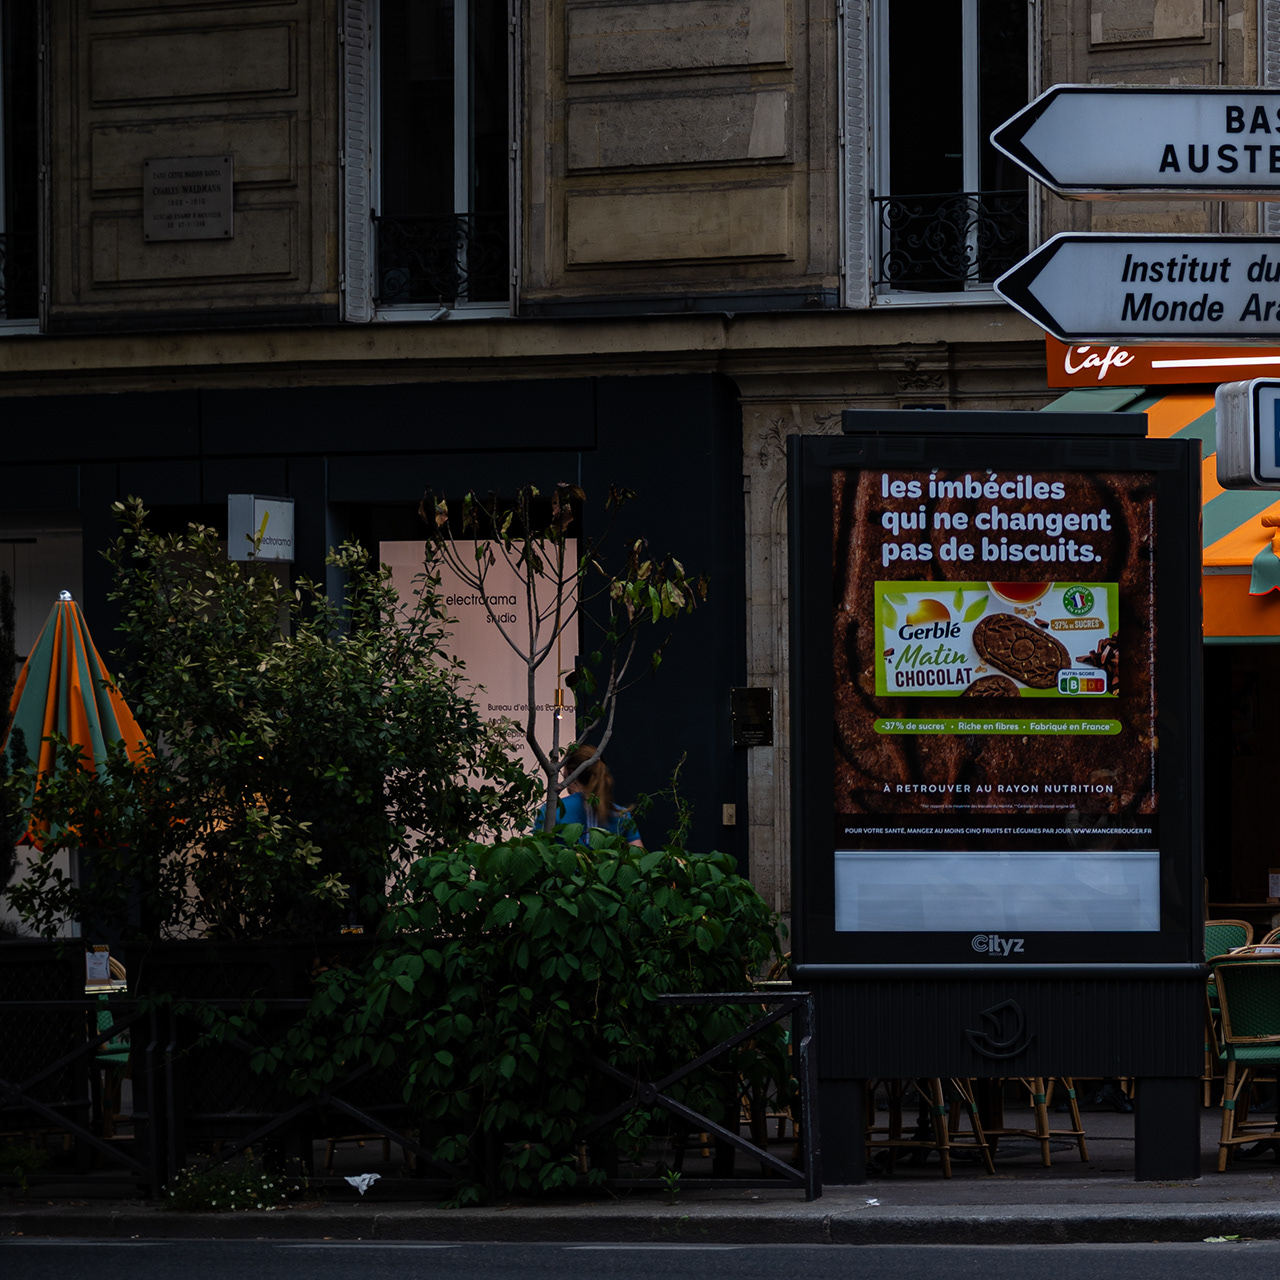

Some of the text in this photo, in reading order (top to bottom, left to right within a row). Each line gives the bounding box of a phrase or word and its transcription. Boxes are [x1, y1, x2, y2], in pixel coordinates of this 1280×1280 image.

[1121, 254, 1231, 284] Institut
[1121, 292, 1224, 322] Monde
[881, 473, 1066, 500] les imbéciles
[881, 504, 1112, 537] qui ne changent
[881, 536, 1102, 568] pas de biscuits.
[486, 613, 517, 623] sudio
[898, 621, 961, 641] Gerblé
[895, 643, 969, 670] Matin
[895, 668, 972, 688] CHOCOLAT
[1070, 680, 1078, 690] B
[487, 703, 512, 711] Bureau
[905, 721, 917, 731] de
[958, 721, 1019, 731] Riche en fibres
[1029, 721, 1068, 733] Fabriqué
[1069, 723, 1080, 732] en
[883, 782, 1114, 794] À RETROUVER AU RAYON NUTRITION
[965, 827, 982, 835] CINQ
[1012, 826, 1041, 834] LÉGUMES
[1073, 827, 1152, 835] WWW.MANGERBOUGER.FR
[971, 933, 1025, 957] Cityz
